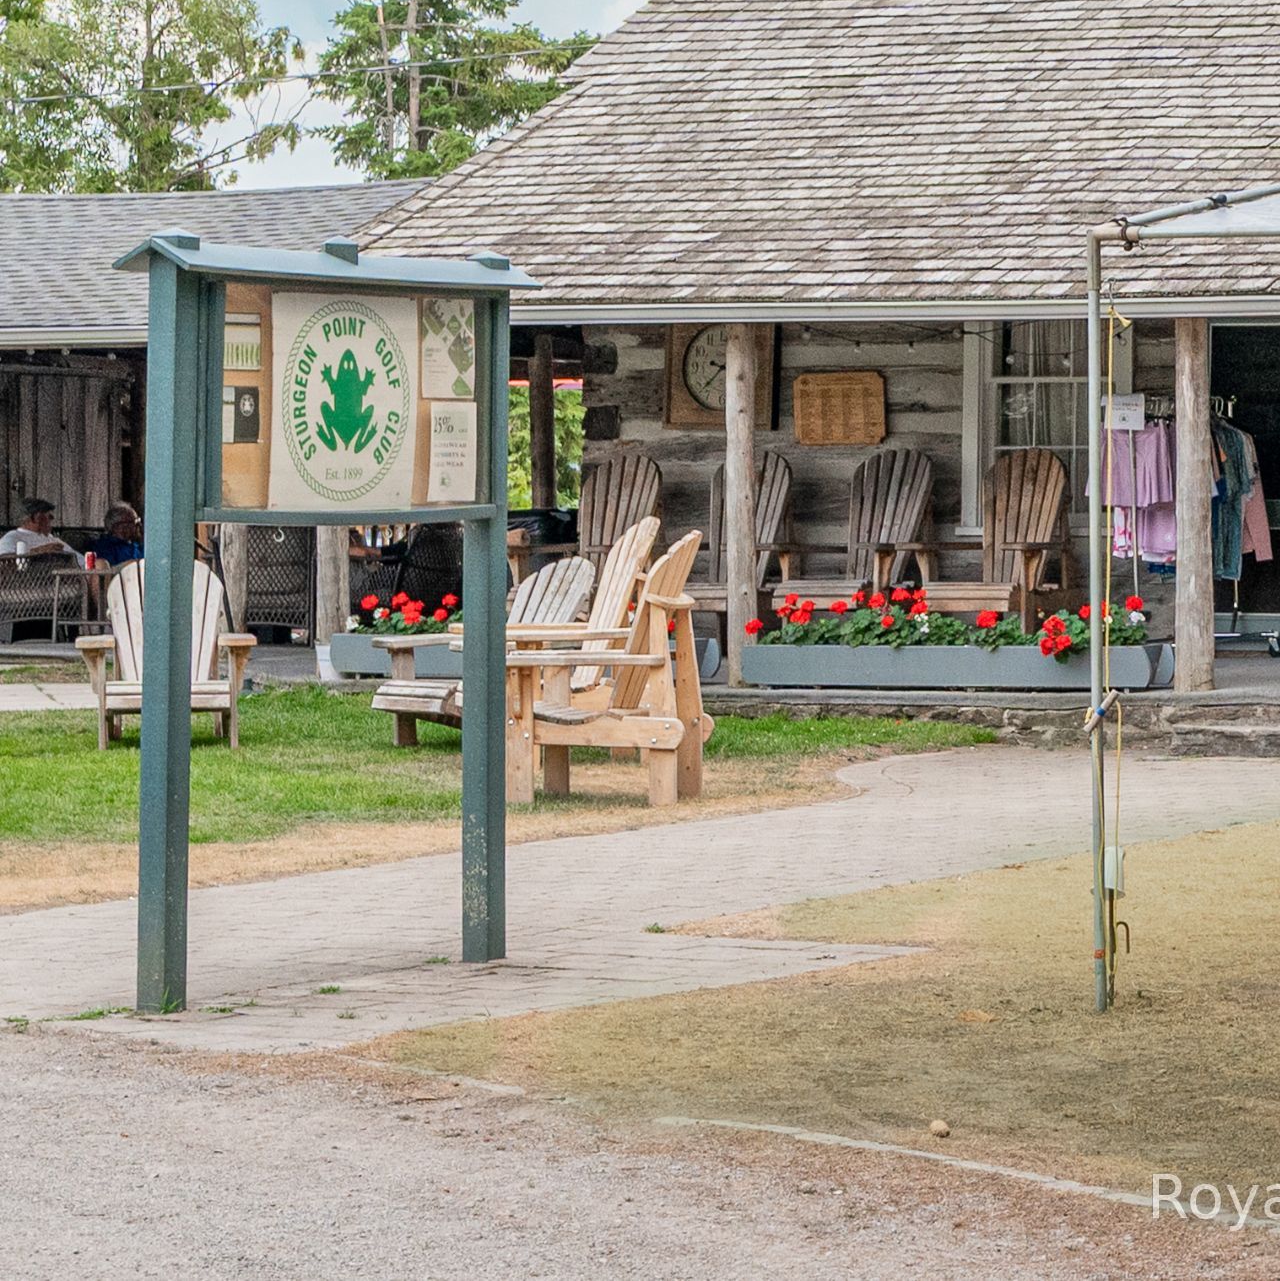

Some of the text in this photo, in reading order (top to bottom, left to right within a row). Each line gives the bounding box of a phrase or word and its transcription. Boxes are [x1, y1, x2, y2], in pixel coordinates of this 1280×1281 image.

[292, 316, 401, 465] STURGEON POINT GOLF CLUB
[325, 468, 340, 480] Est.
